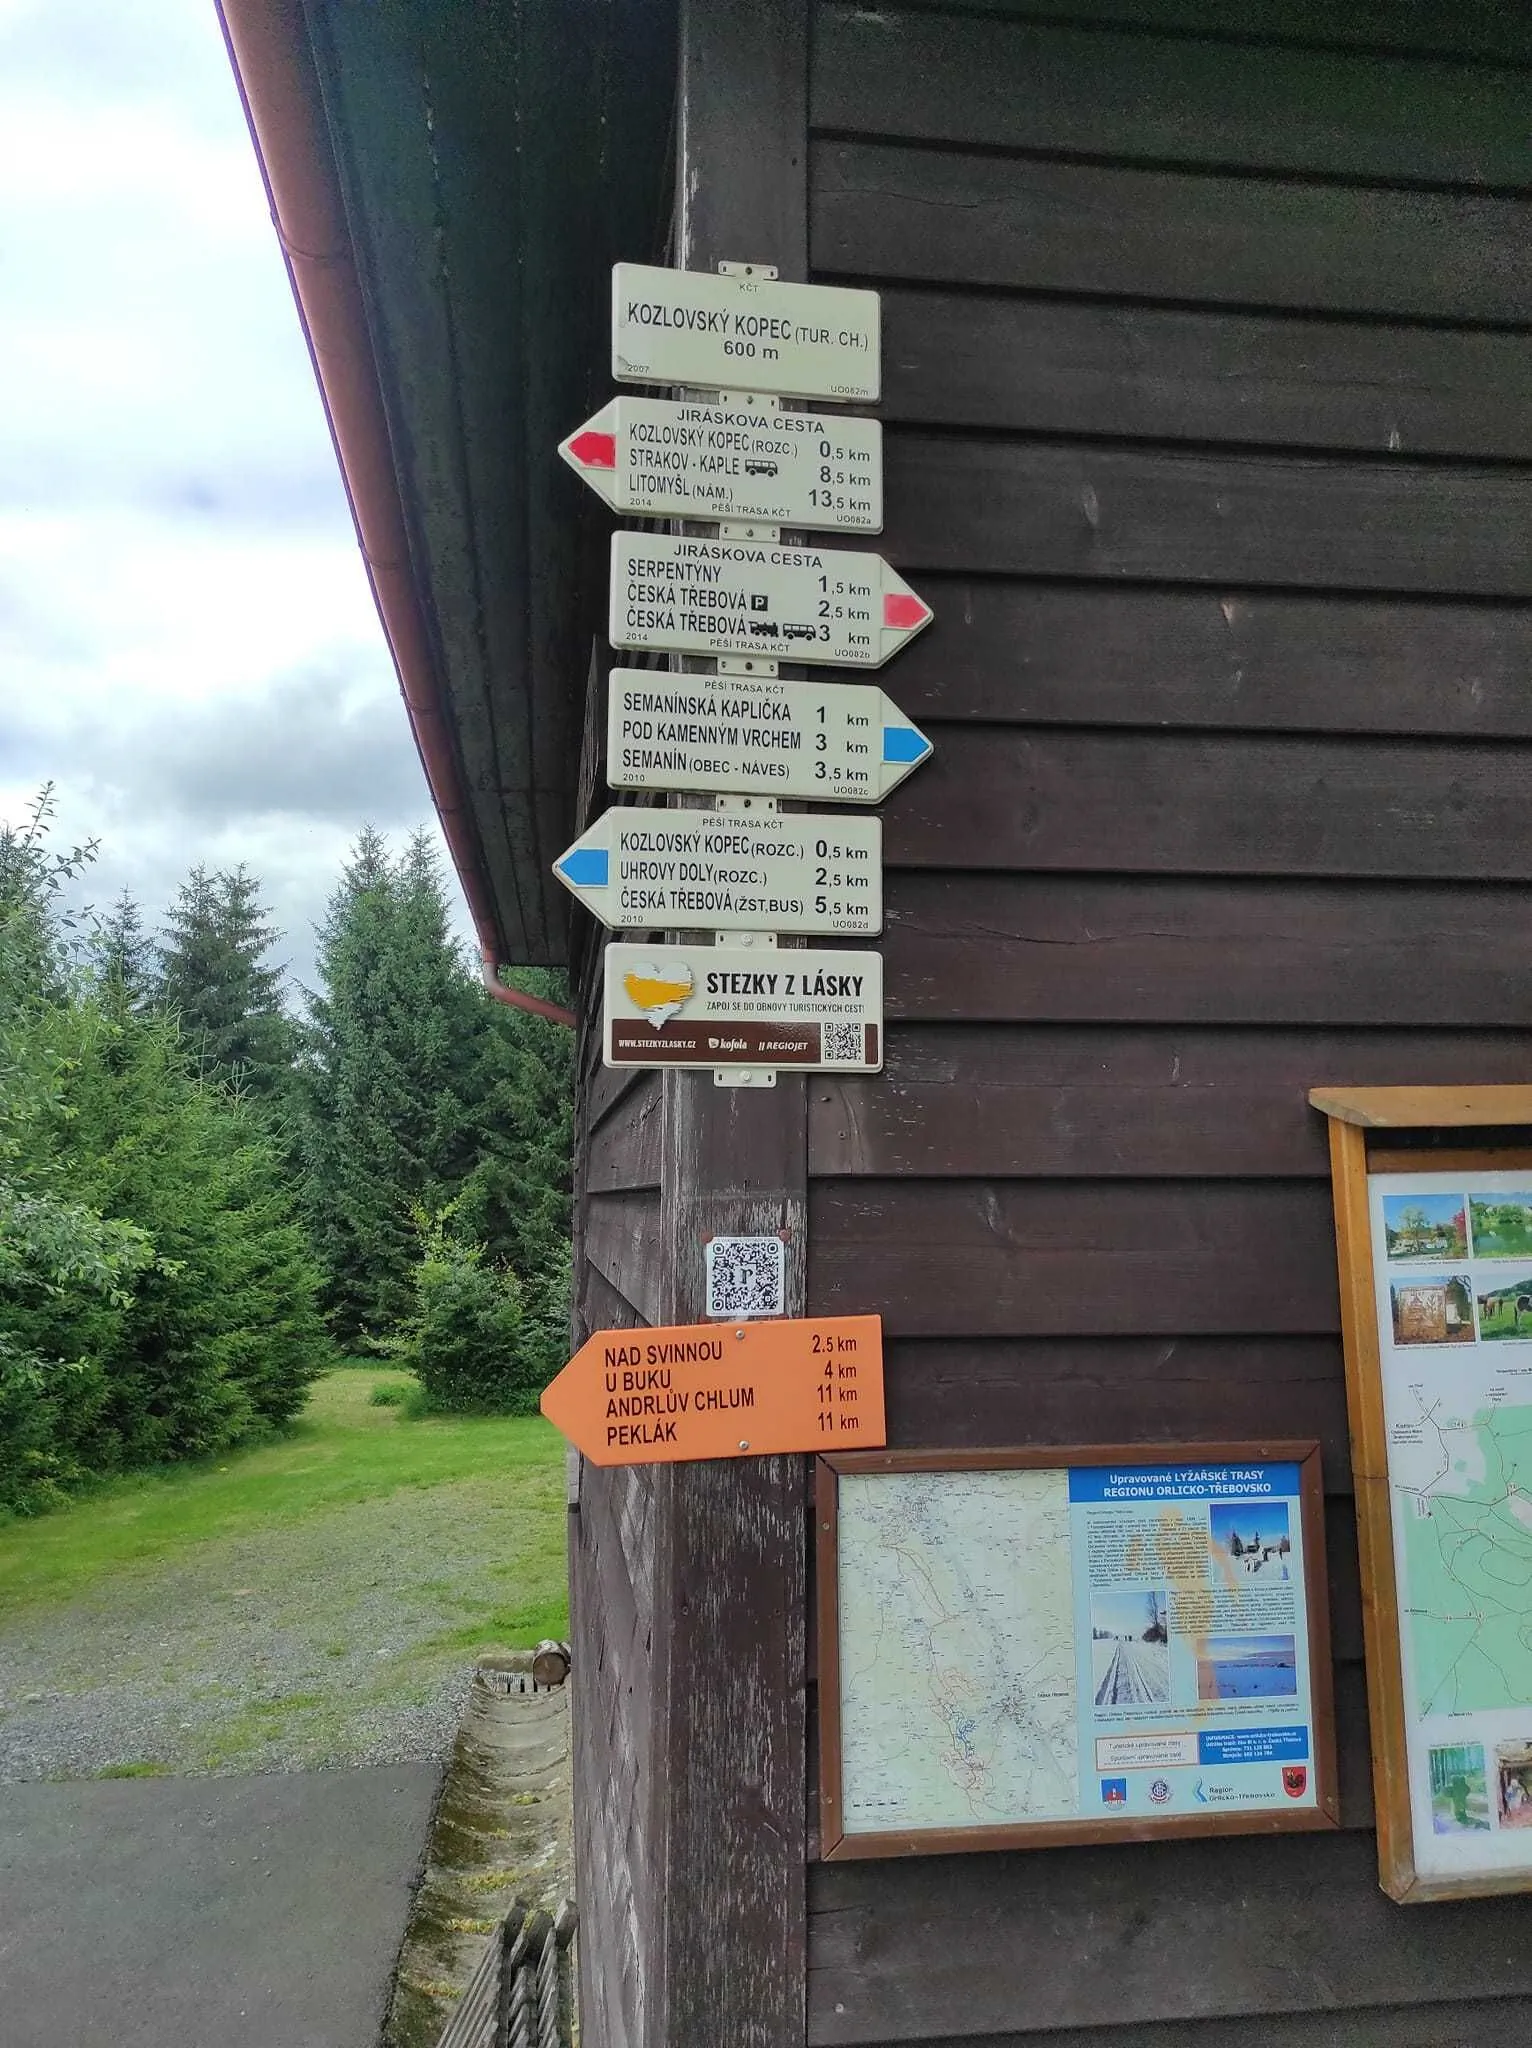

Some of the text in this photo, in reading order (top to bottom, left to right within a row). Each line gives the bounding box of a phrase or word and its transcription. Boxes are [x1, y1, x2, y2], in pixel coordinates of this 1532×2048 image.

[628, 302, 868, 352] KOZLOVSKÝ KOPEC (TUR. CH.)
[724, 341, 779, 360] 600 m
[677, 408, 825, 434] JIRÁSKOVA CESTA
[630, 423, 704, 446] KOZLOVSKÝ
[820, 440, 844, 461] 0,5
[849, 450, 870, 462] km
[630, 449, 689, 470] STRAKOV
[700, 456, 740, 475] KAPLE
[820, 465, 844, 486] 8,5
[849, 474, 871, 487] km
[630, 498, 652, 506] 2014
[737, 506, 768, 515] TRASA
[772, 507, 791, 518] KČT
[808, 489, 844, 510] 13,5
[849, 500, 871, 511] km
[674, 543, 822, 568] JIRÁSKOVA CESTA
[628, 558, 870, 596] SERPENTÝNY 1,5 km
[628, 581, 675, 605] ČESKÁ
[680, 587, 747, 610] TŘEBOVÁ
[818, 600, 843, 619] 2,5
[848, 608, 870, 620] km
[626, 632, 648, 641] 2014
[627, 606, 870, 645] ČESKÁ TŘEBOVÁ 3 km
[735, 640, 767, 650] TRASA
[771, 642, 789, 652] KČT
[730, 683, 762, 693] TRASA
[765, 684, 785, 694] KČT
[624, 691, 869, 727] SEMANÍNSKÁ KAPLIČKA 1 km
[623, 721, 868, 754] POD KAMENNÝM VRCHEM 3 km
[623, 773, 645, 782] 2010
[742, 760, 789, 780] NÁVES)
[815, 761, 841, 780] 3,5
[847, 768, 868, 781] km
[728, 819, 760, 828] TRASA
[764, 819, 783, 829] KČT
[621, 830, 700, 853] KOZLOVSKÝ
[815, 840, 841, 859] 0,5
[846, 847, 868, 859] km
[621, 862, 675, 881] UHROVY
[815, 868, 841, 887] 2,5
[846, 875, 868, 887] km
[621, 885, 666, 909] ČESKÁ
[815, 896, 841, 915] 5,5
[847, 903, 868, 915] km
[621, 915, 643, 923] 2010
[707, 969, 863, 997] STEZKY Z LÁSKY
[706, 1001, 729, 1011] ZAPOJ
[730, 1002, 741, 1011] SE
[743, 1002, 754, 1011] DO
[757, 1002, 787, 1012] OBNOVY
[720, 1038, 747, 1052] kofola
[605, 1335, 857, 1367] NAD SVINNOU 2.5 km
[606, 1360, 857, 1392] U BUKU 4 km
[606, 1384, 858, 1418] ANDRLŮV CHLUM 11 km
[607, 1412, 858, 1446] PEKLÁK 11 km
[1104, 1482, 1271, 1496] REGIONU ORLICKO-TŘEBOVSKO
[1110, 1469, 1264, 1484] Upravované LYŽAŘSKÉ TRASY
